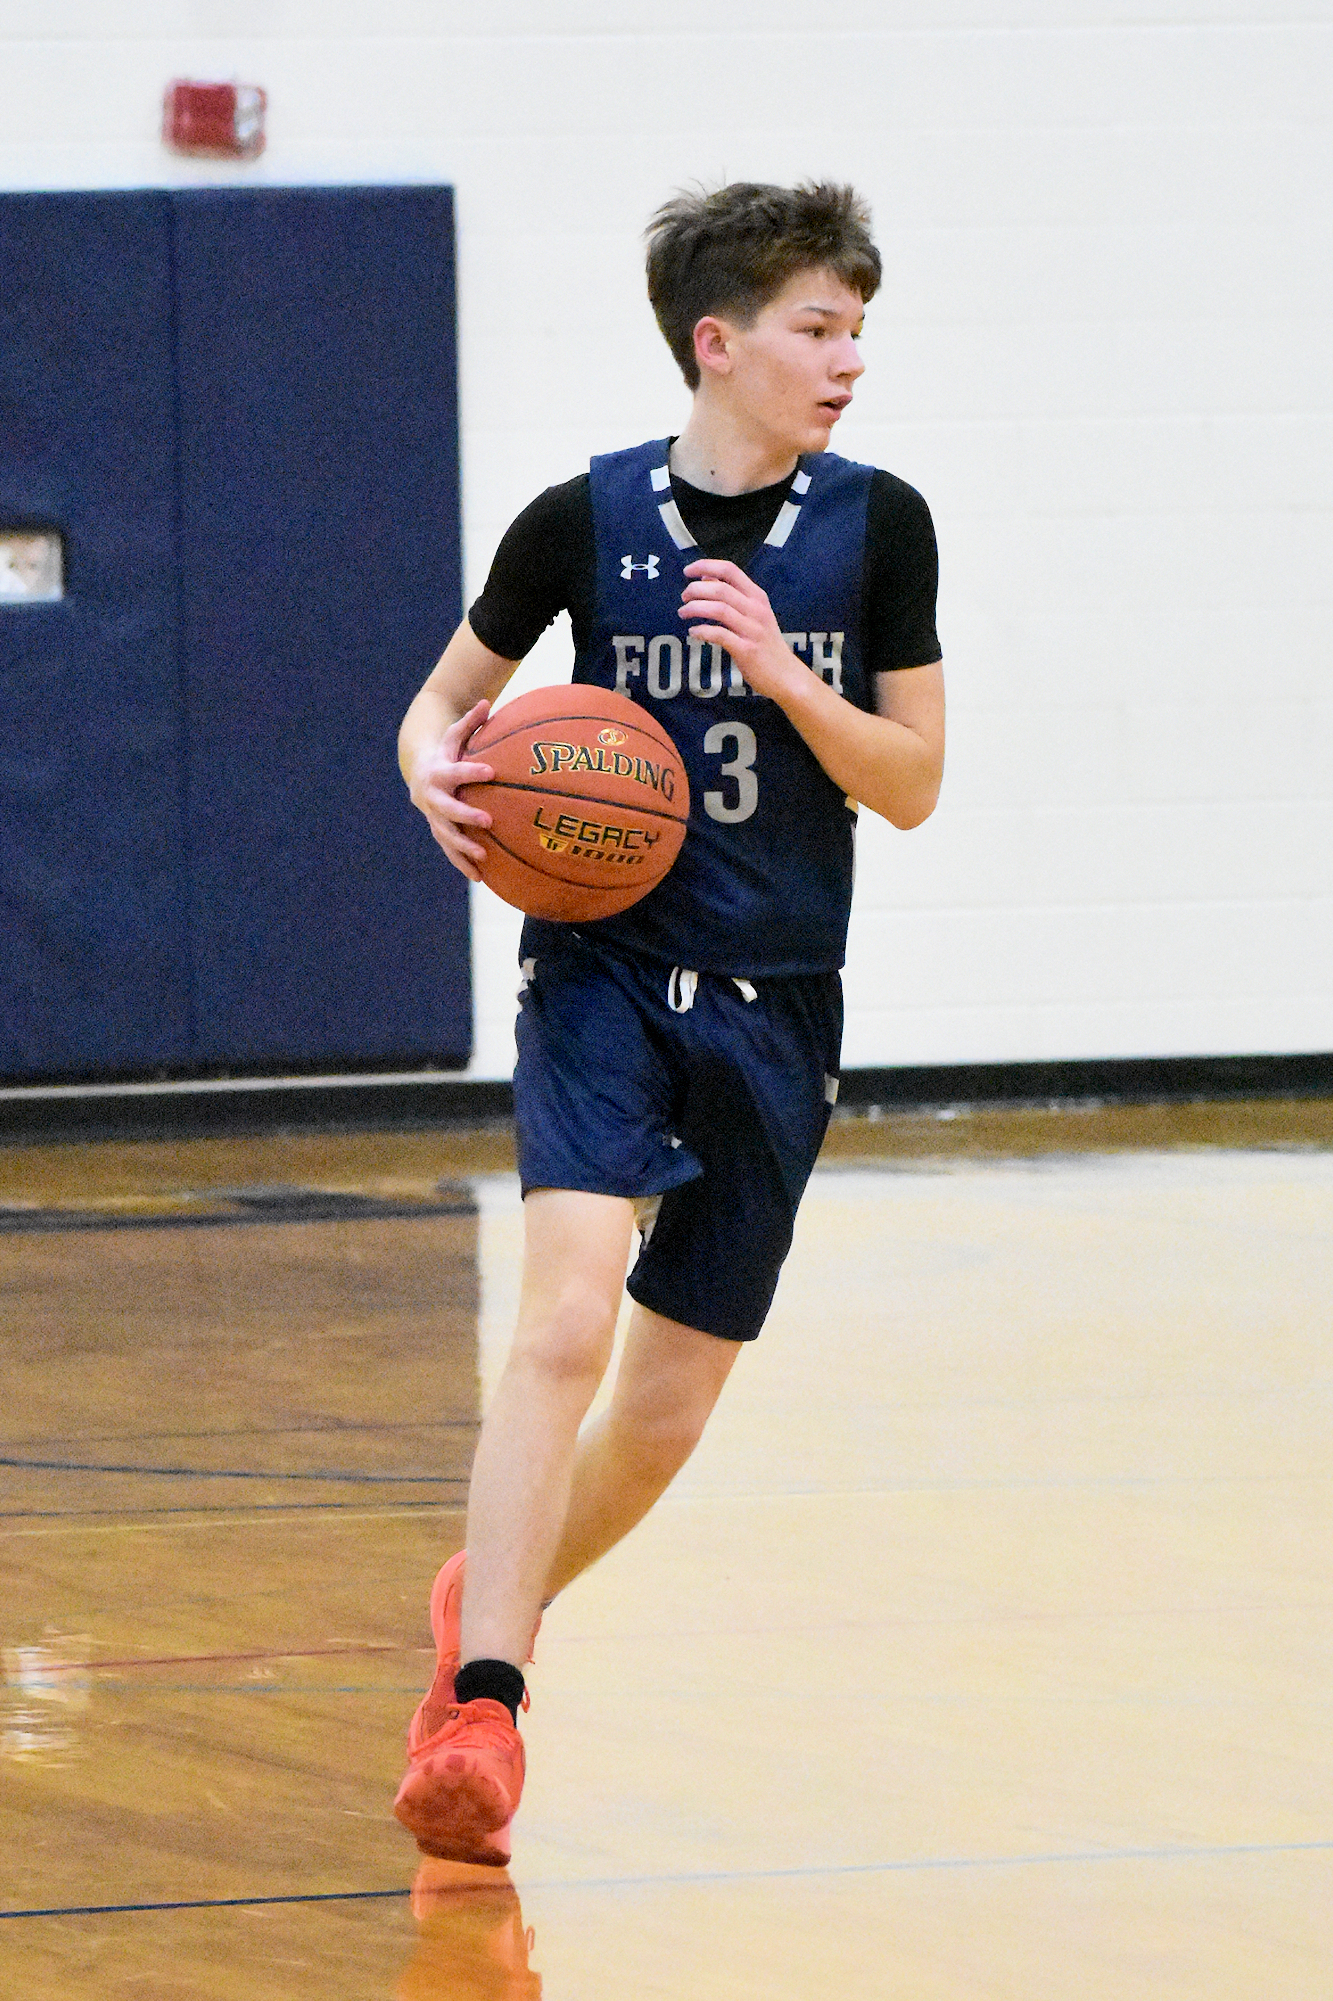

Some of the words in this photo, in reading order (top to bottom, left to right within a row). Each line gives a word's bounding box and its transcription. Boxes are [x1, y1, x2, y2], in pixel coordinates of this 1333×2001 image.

[530, 741, 675, 802] SPALDING
[703, 721, 758, 824] 3
[533, 806, 660, 850] LEGACY
[571, 845, 645, 865] 1000
